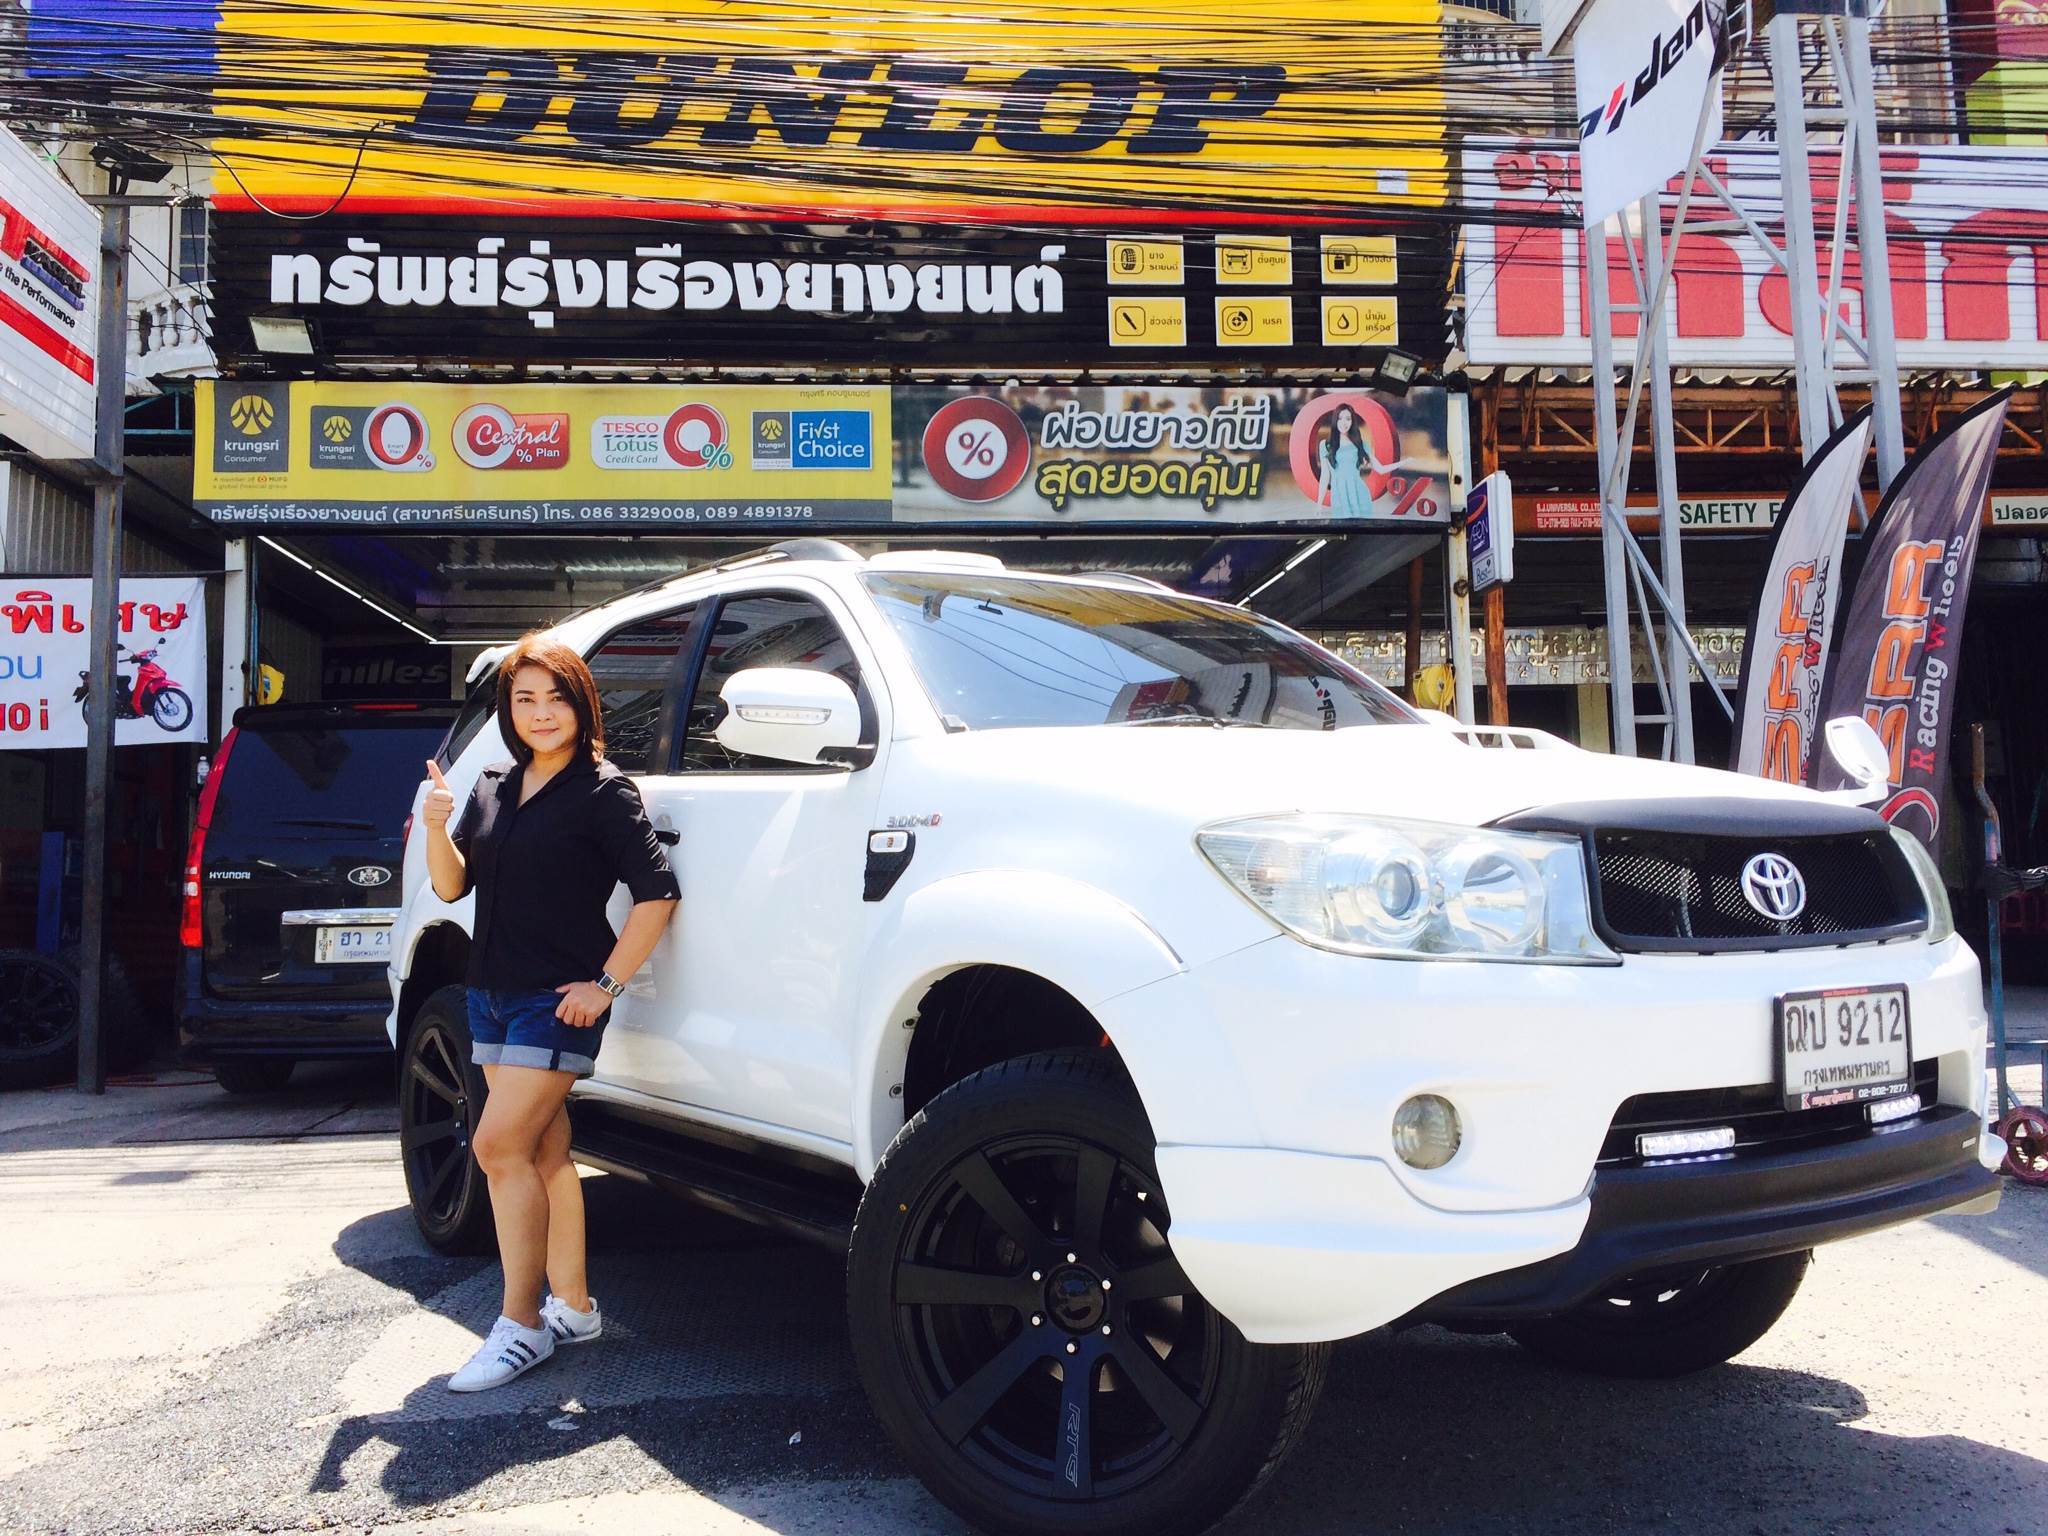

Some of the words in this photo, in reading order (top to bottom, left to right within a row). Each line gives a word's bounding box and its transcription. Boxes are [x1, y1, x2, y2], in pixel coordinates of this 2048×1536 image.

[402, 52, 1287, 155] DUNLOP
[270, 237, 1067, 329] ทรัพย์รุ่งเรืองยางยนต์
[5, 265, 20, 286] the
[21, 279, 76, 329] Performance
[475, 419, 561, 446] Central
[602, 422, 659, 433] TESCO
[1043, 396, 1270, 448] ผ่อนยาวที่นี่
[224, 440, 279, 453] krungsri
[319, 444, 356, 454] krungsri
[536, 448, 561, 457] Plan
[605, 438, 659, 452] Lotus
[757, 441, 786, 450] krungsri
[798, 440, 865, 458] Choice
[224, 455, 267, 463] Consumer
[605, 454, 634, 464] Credit
[636, 454, 658, 464] Card
[1039, 455, 1262, 509] สุดยอดคุ้ม!
[211, 504, 388, 524] ทรัพย์รุ่งเรืองยางยนต์
[392, 505, 539, 522] (สาขาศรีนครินทร์)
[543, 503, 575, 520] โทร.
[580, 506, 613, 519] 086
[619, 506, 700, 521] 3329008,
[705, 507, 738, 519] 089
[743, 506, 813, 519] 4891378
[1679, 502, 1756, 525] SAFETY
[1925, 535, 1963, 651] Wheels
[1909, 656, 1948, 774] Racing
[209, 871, 251, 880] HYUNDAI
[1838, 996, 1903, 1047] 9212
[1804, 1060, 1890, 1091] กรุงเทพมหานคร
[1858, 1084, 1908, 1098] 02-802-7277
